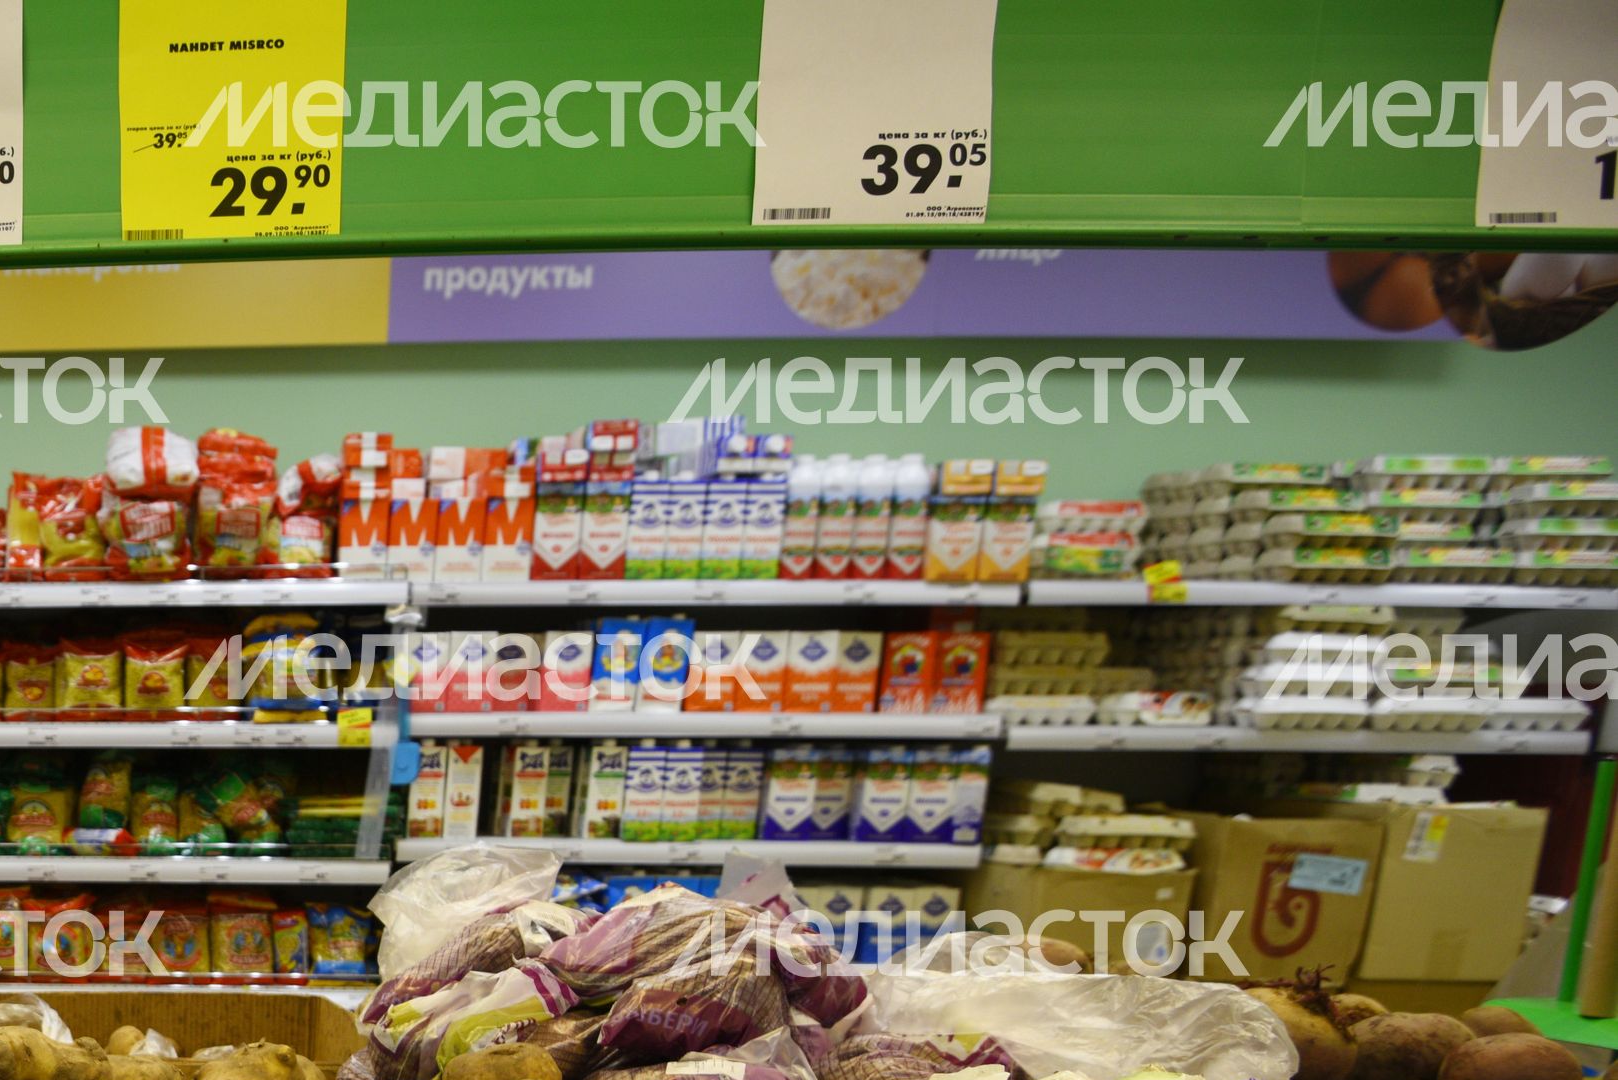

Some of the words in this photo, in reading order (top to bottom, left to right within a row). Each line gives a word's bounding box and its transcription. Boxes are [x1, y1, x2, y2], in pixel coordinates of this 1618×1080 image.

[169, 41, 225, 54] NAHDET
[229, 38, 285, 52] MISRCO
[878, 132, 910, 141] цена
[933, 131, 947, 139] кг
[951, 129, 988, 140] (руб.)
[227, 154, 257, 163] цена
[279, 152, 292, 161] кг
[296, 150, 332, 162] (руб.)
[861, 143, 987, 196] 39.05
[209, 164, 331, 217] 29.90
[423, 260, 593, 300] продукты
